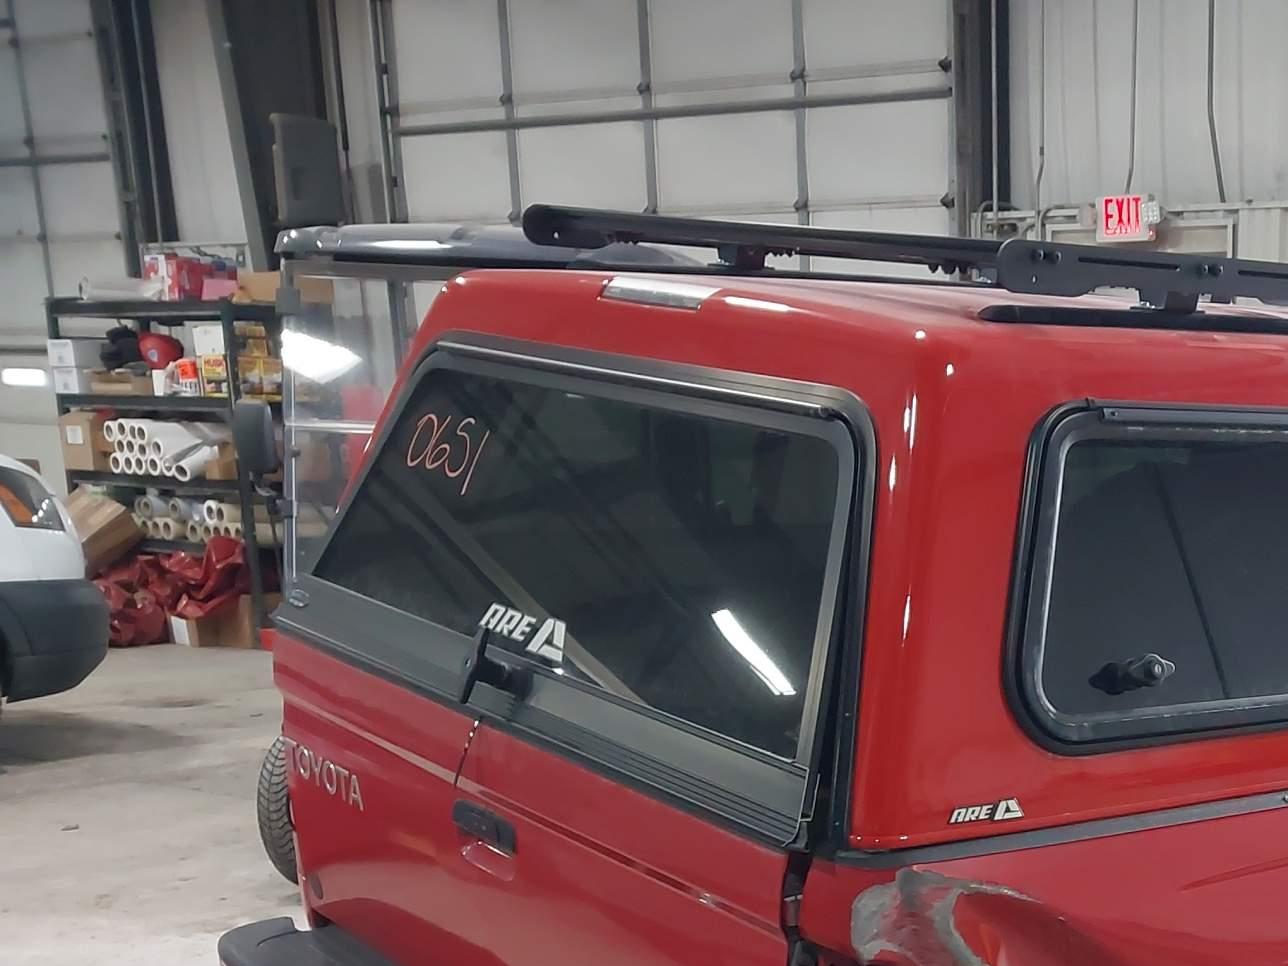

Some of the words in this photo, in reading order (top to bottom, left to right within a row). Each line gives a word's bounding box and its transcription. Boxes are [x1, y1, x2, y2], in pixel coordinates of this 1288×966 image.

[1104, 197, 1141, 234] EXIT
[407, 413, 490, 496] 0651
[279, 736, 364, 812] TOYOTA
